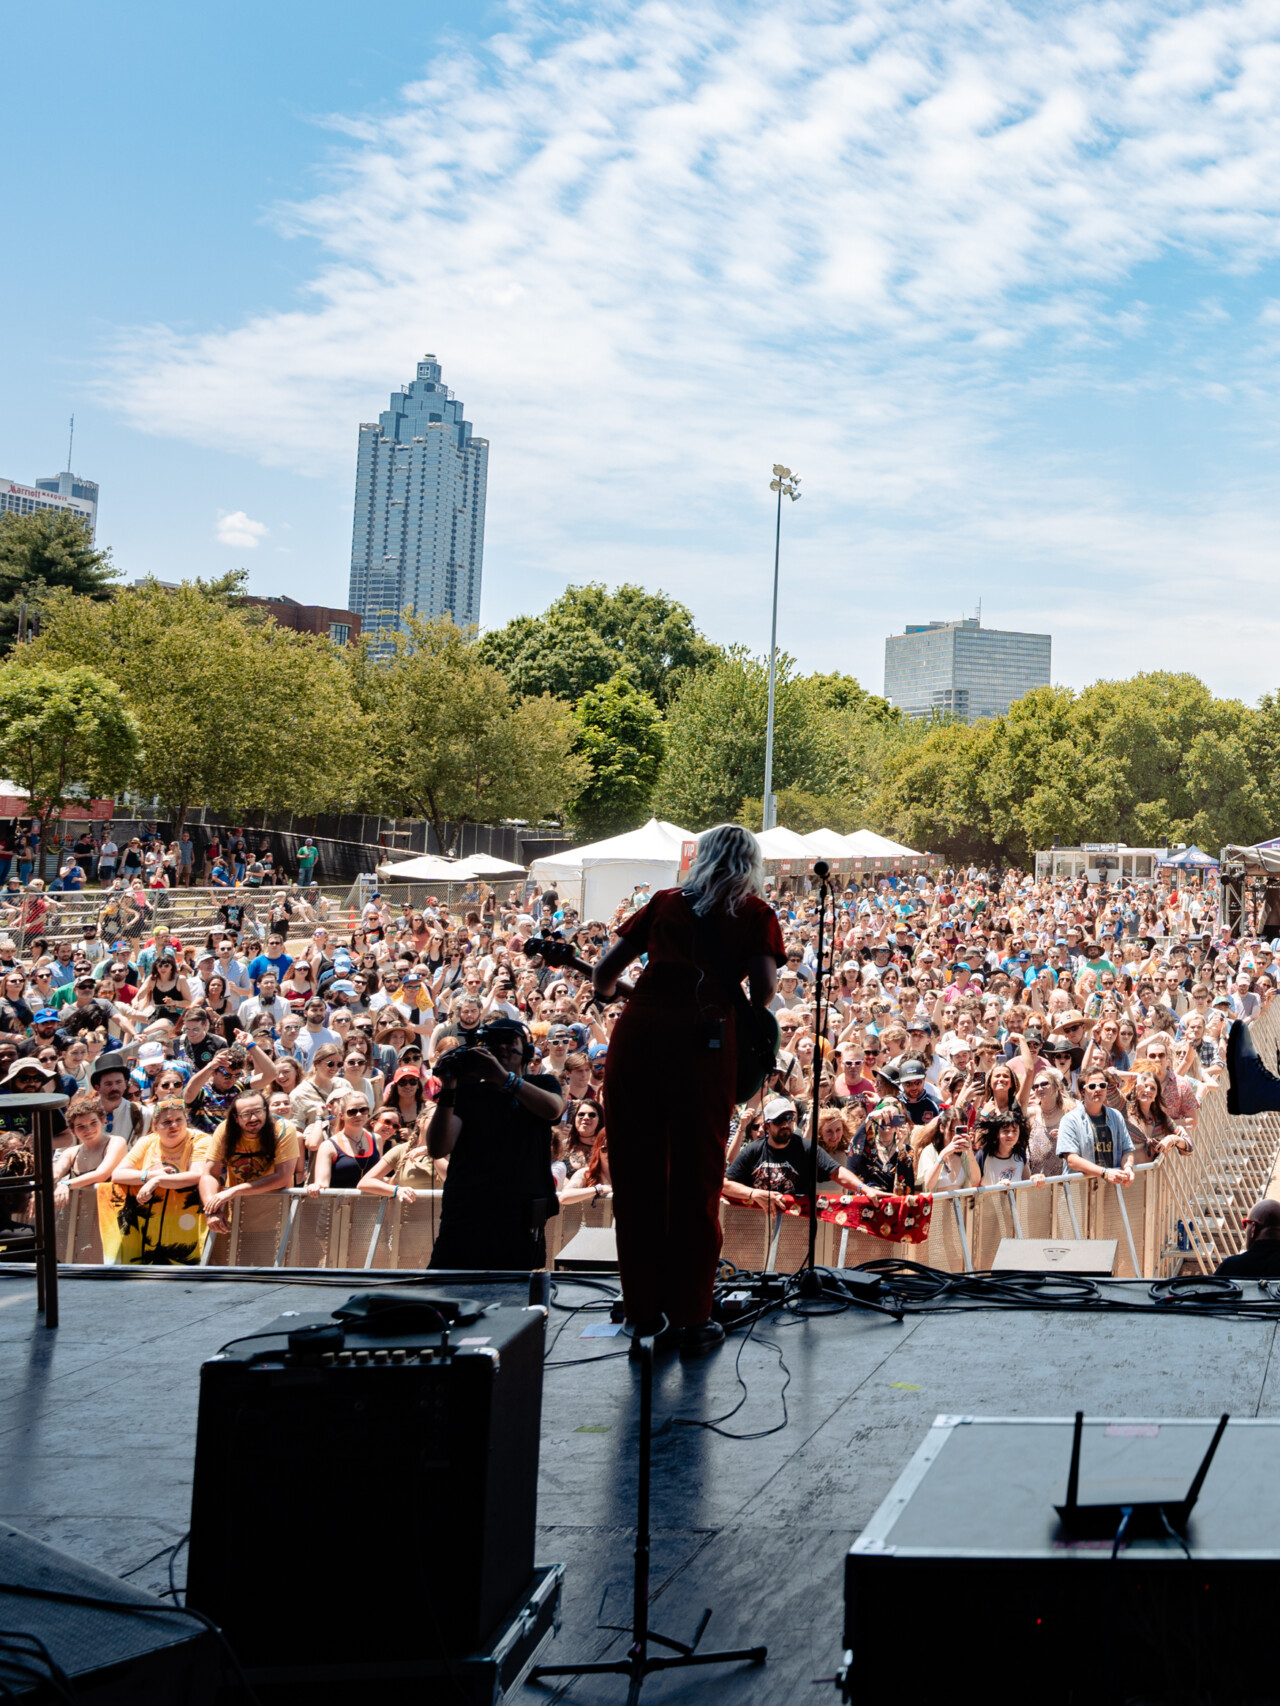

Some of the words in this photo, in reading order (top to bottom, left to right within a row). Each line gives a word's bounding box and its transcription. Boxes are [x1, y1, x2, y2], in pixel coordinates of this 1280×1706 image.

[8, 484, 41, 499] Marriott
[41, 492, 68, 501] MARQUIS
[684, 843, 695, 857] VIP
